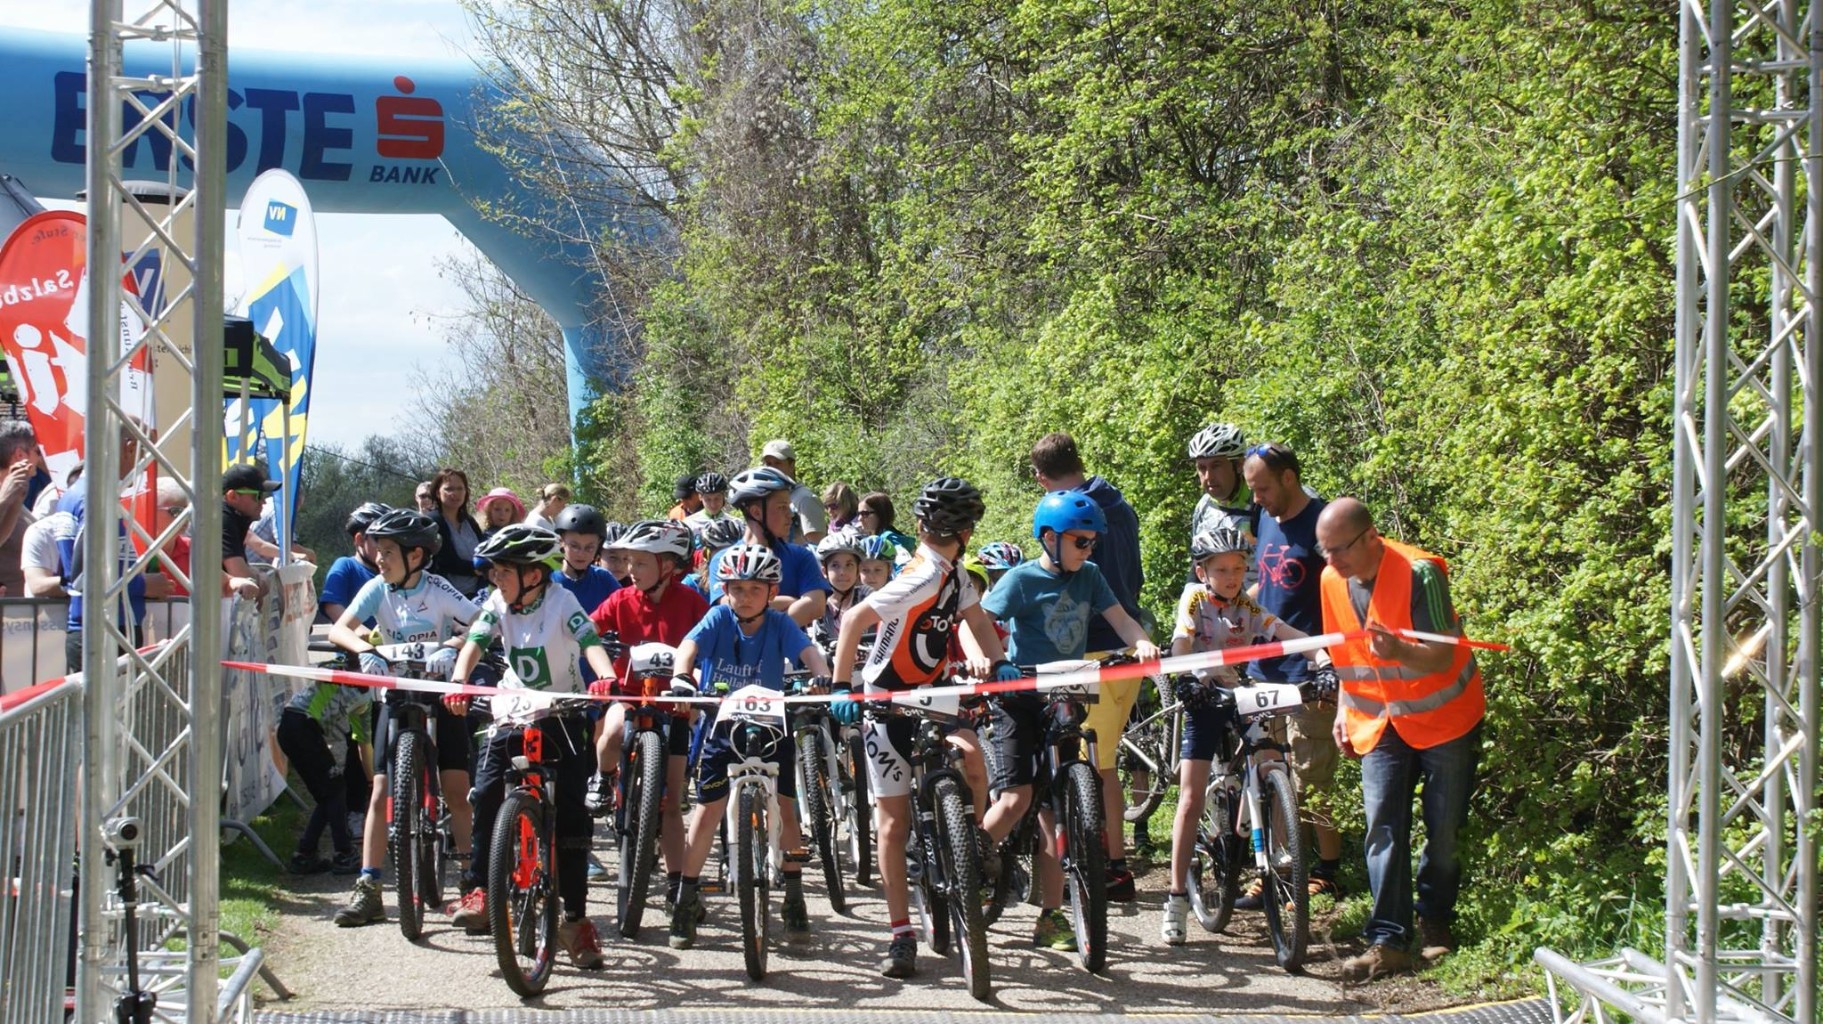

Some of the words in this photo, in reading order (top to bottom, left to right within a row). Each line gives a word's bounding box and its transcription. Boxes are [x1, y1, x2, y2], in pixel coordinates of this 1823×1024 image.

[51, 71, 356, 181] ERSTE
[369, 165, 441, 185] BANK
[391, 643, 425, 660] 143
[649, 652, 674, 667] 43
[736, 696, 771, 712] 163
[1255, 690, 1279, 708] 67
